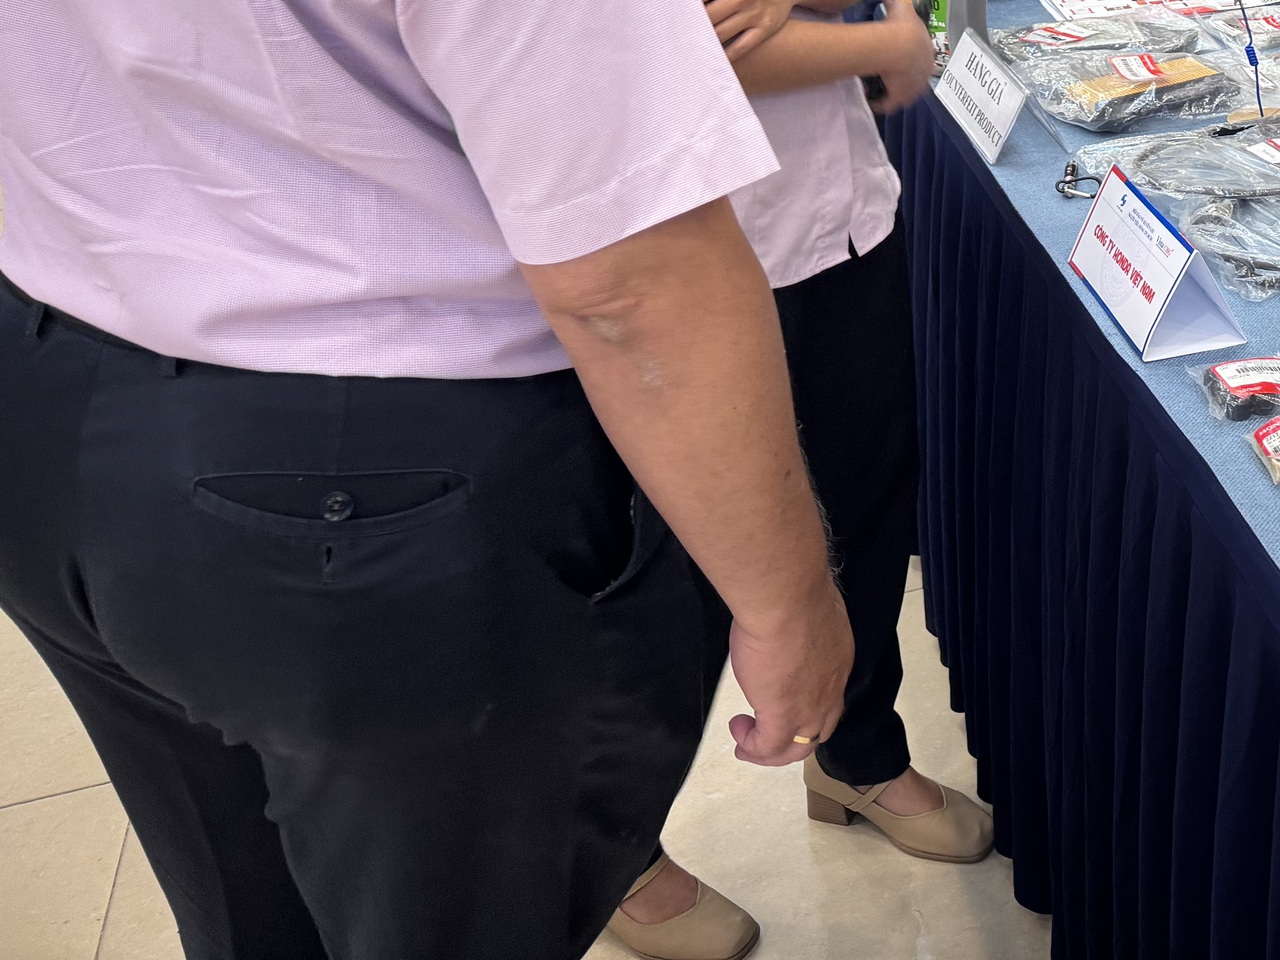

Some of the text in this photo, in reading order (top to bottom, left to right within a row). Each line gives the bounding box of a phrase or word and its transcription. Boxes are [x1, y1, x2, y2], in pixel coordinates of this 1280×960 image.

[943, 69, 1003, 147] COUNTERFEIT PRODUCT
[965, 51, 1007, 105] HÀNG GIẢ
[1094, 224, 1155, 304] CÔNG TY HONDA VIỆT NAM
